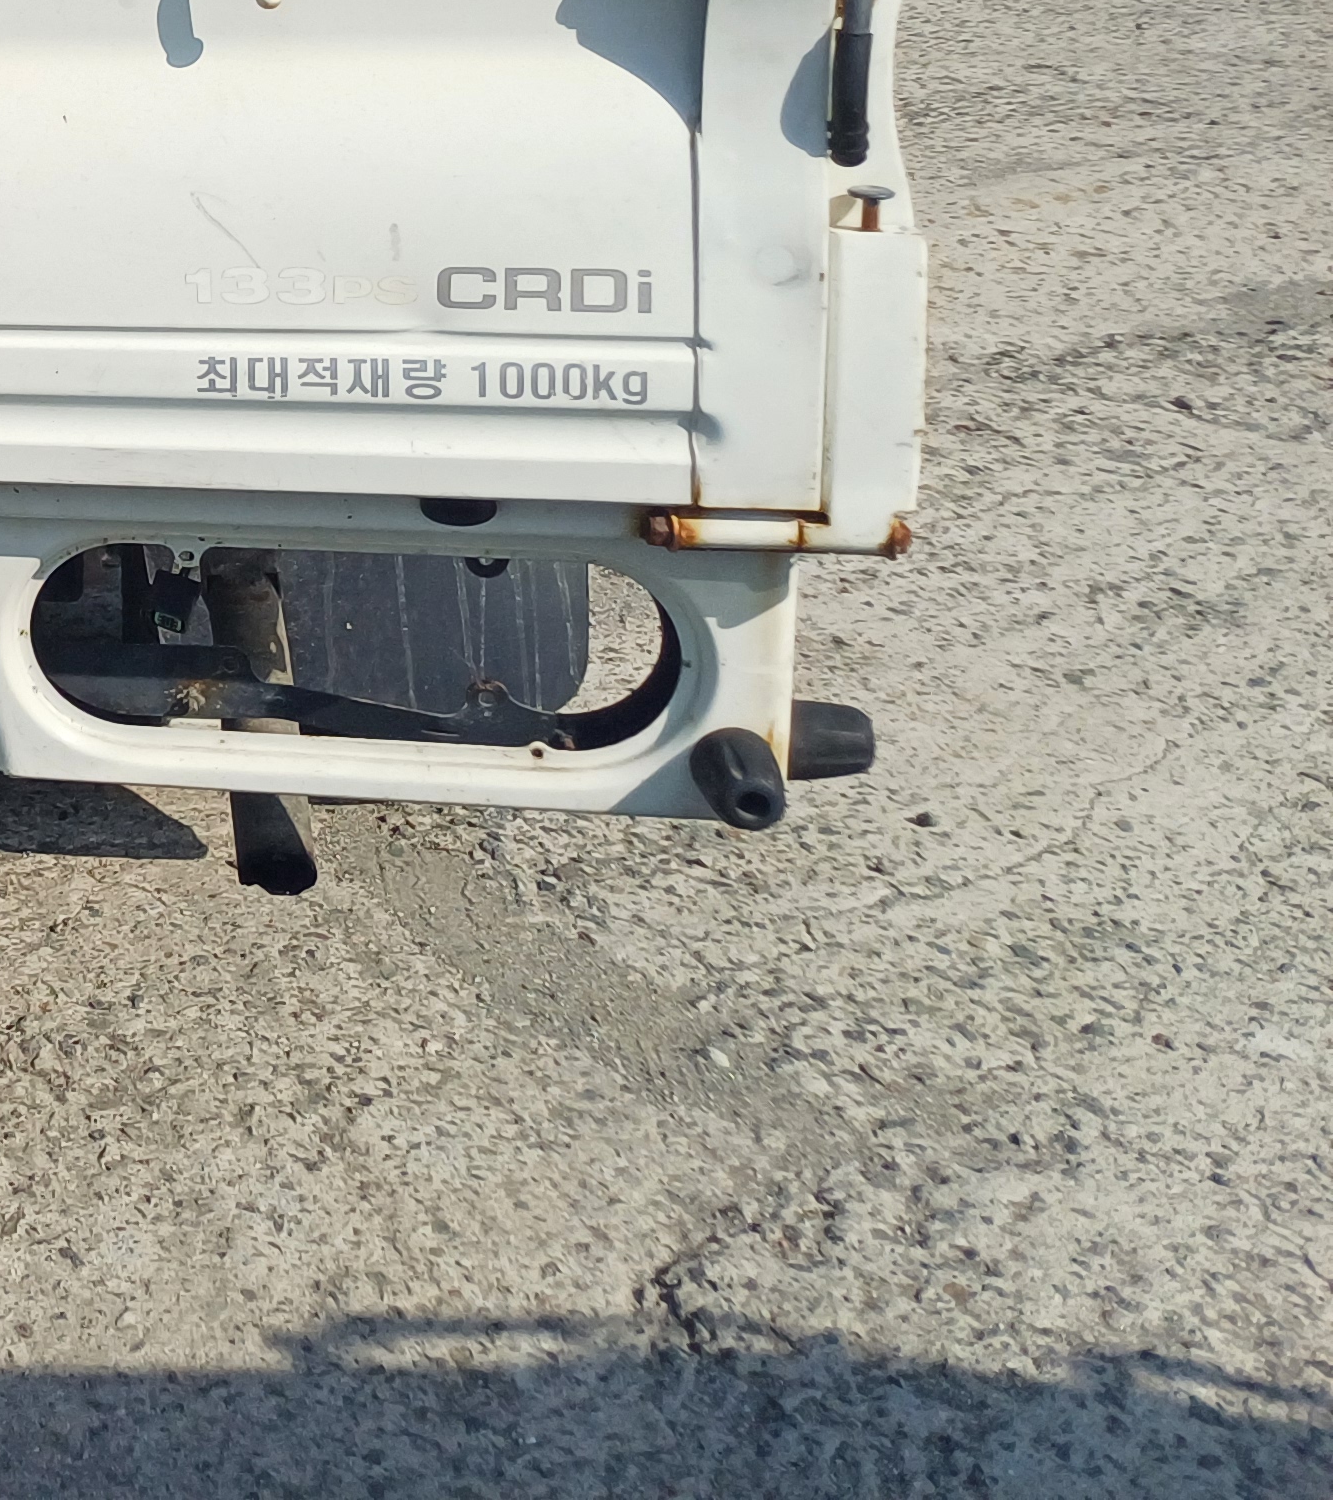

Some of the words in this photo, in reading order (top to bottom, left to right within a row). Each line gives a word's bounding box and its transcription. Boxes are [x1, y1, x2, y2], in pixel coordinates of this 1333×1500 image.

[436, 266, 654, 314] CRDi
[195, 355, 448, 400] 최대적재량
[470, 361, 650, 406] 1000kg
